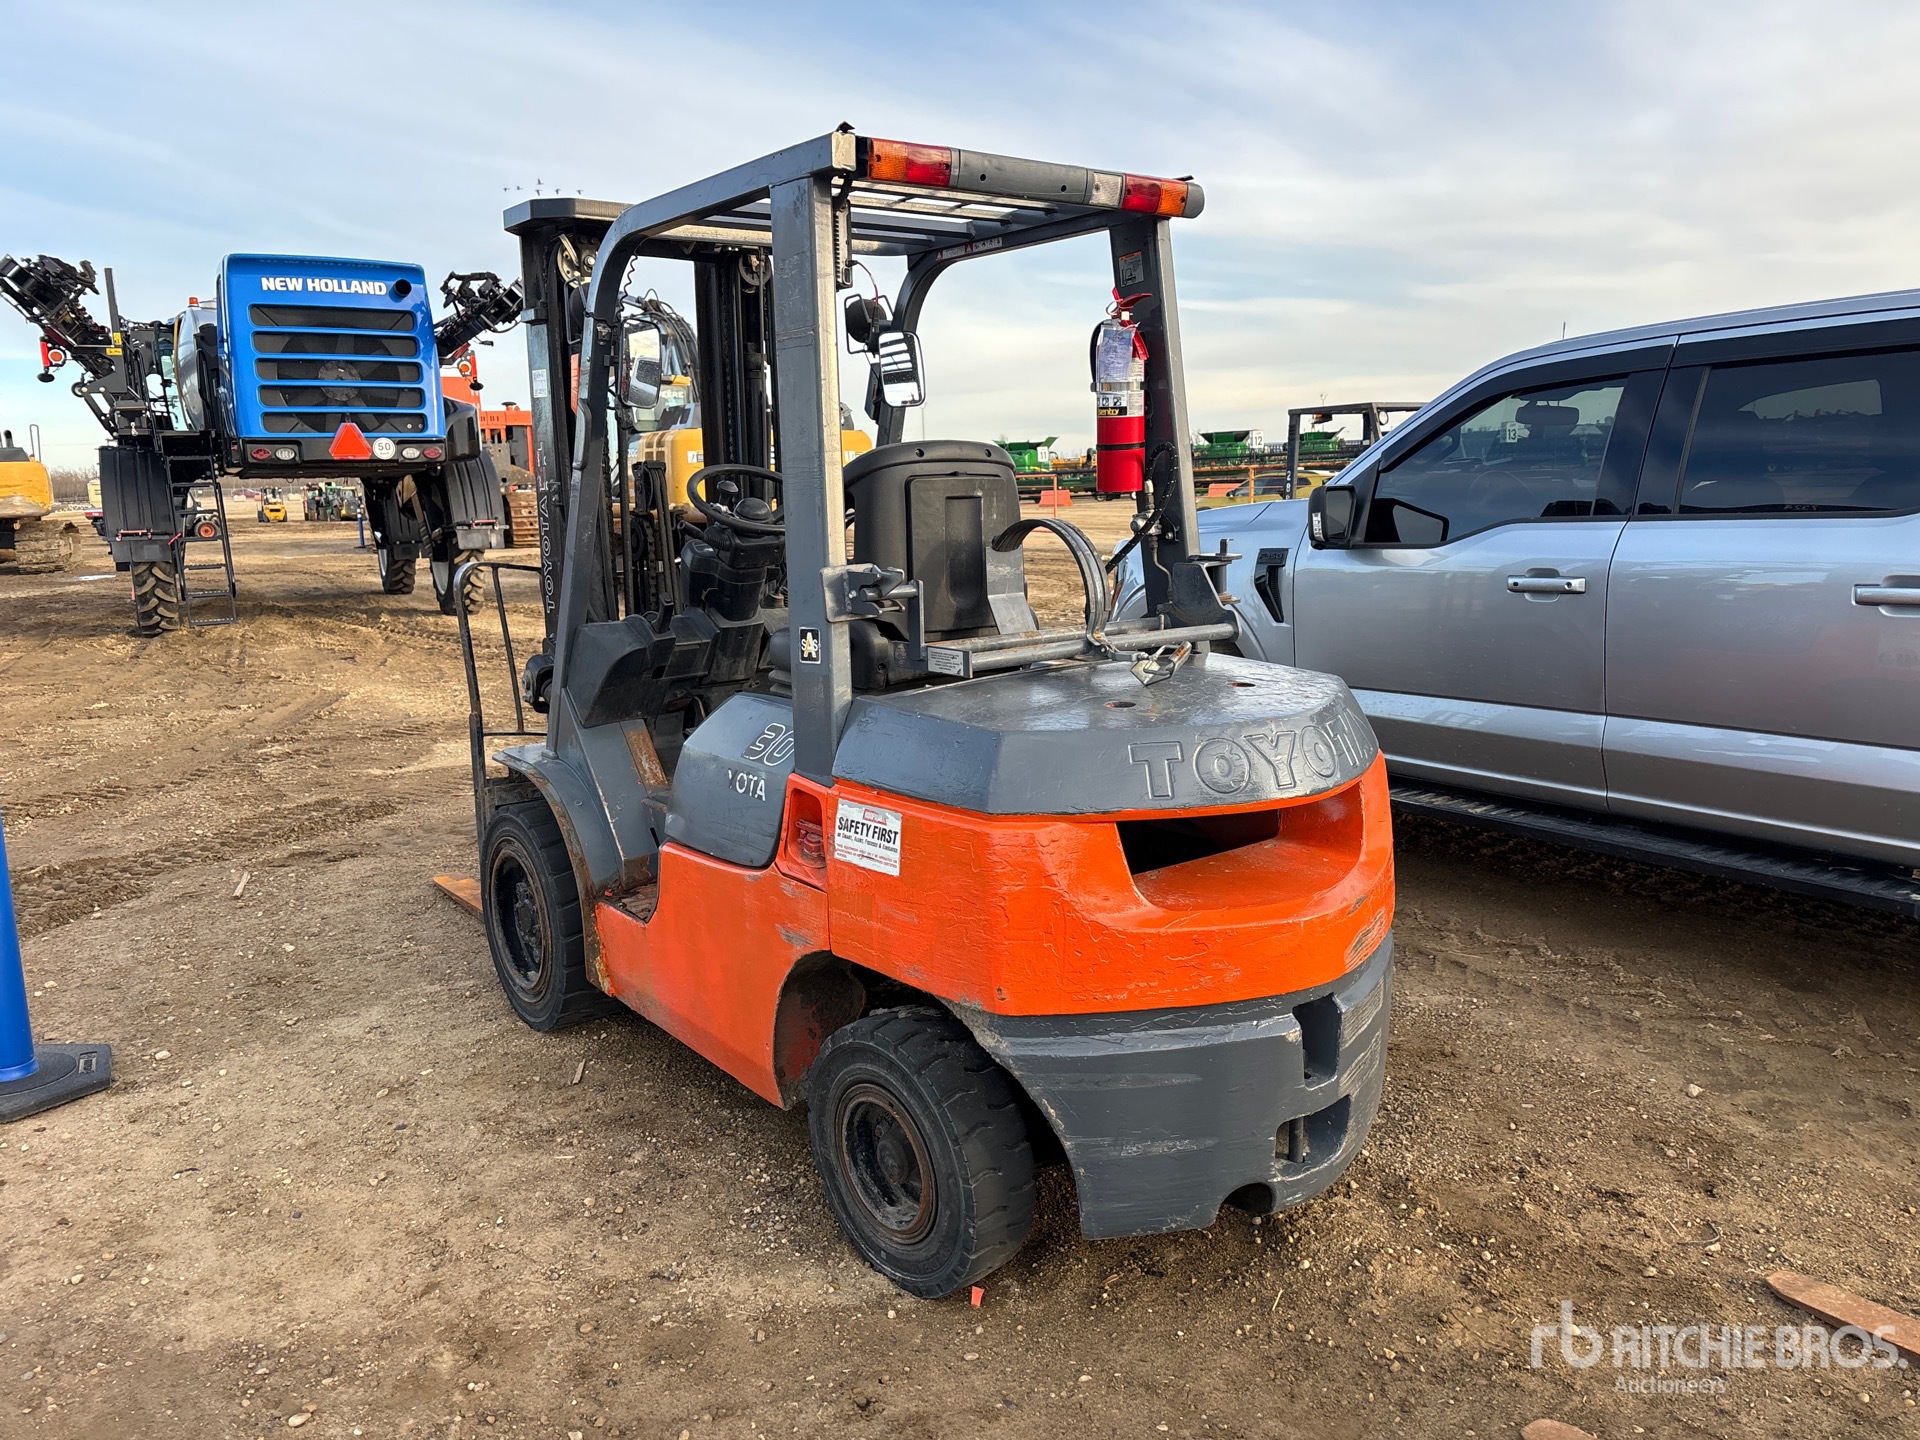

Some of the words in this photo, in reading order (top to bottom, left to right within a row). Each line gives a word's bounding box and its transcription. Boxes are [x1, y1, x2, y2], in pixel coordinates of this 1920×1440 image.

[261, 277, 303, 291] NEW
[306, 278, 387, 296] HOLLAND
[1254, 436, 1263, 446] 12
[1507, 428, 1517, 440] 13
[377, 442, 391, 451] 50
[539, 495, 556, 613] TOYOTA
[1127, 706, 1375, 800] TOYOTA
[837, 816, 872, 838] SAFETY
[871, 825, 899, 845] FIRST
